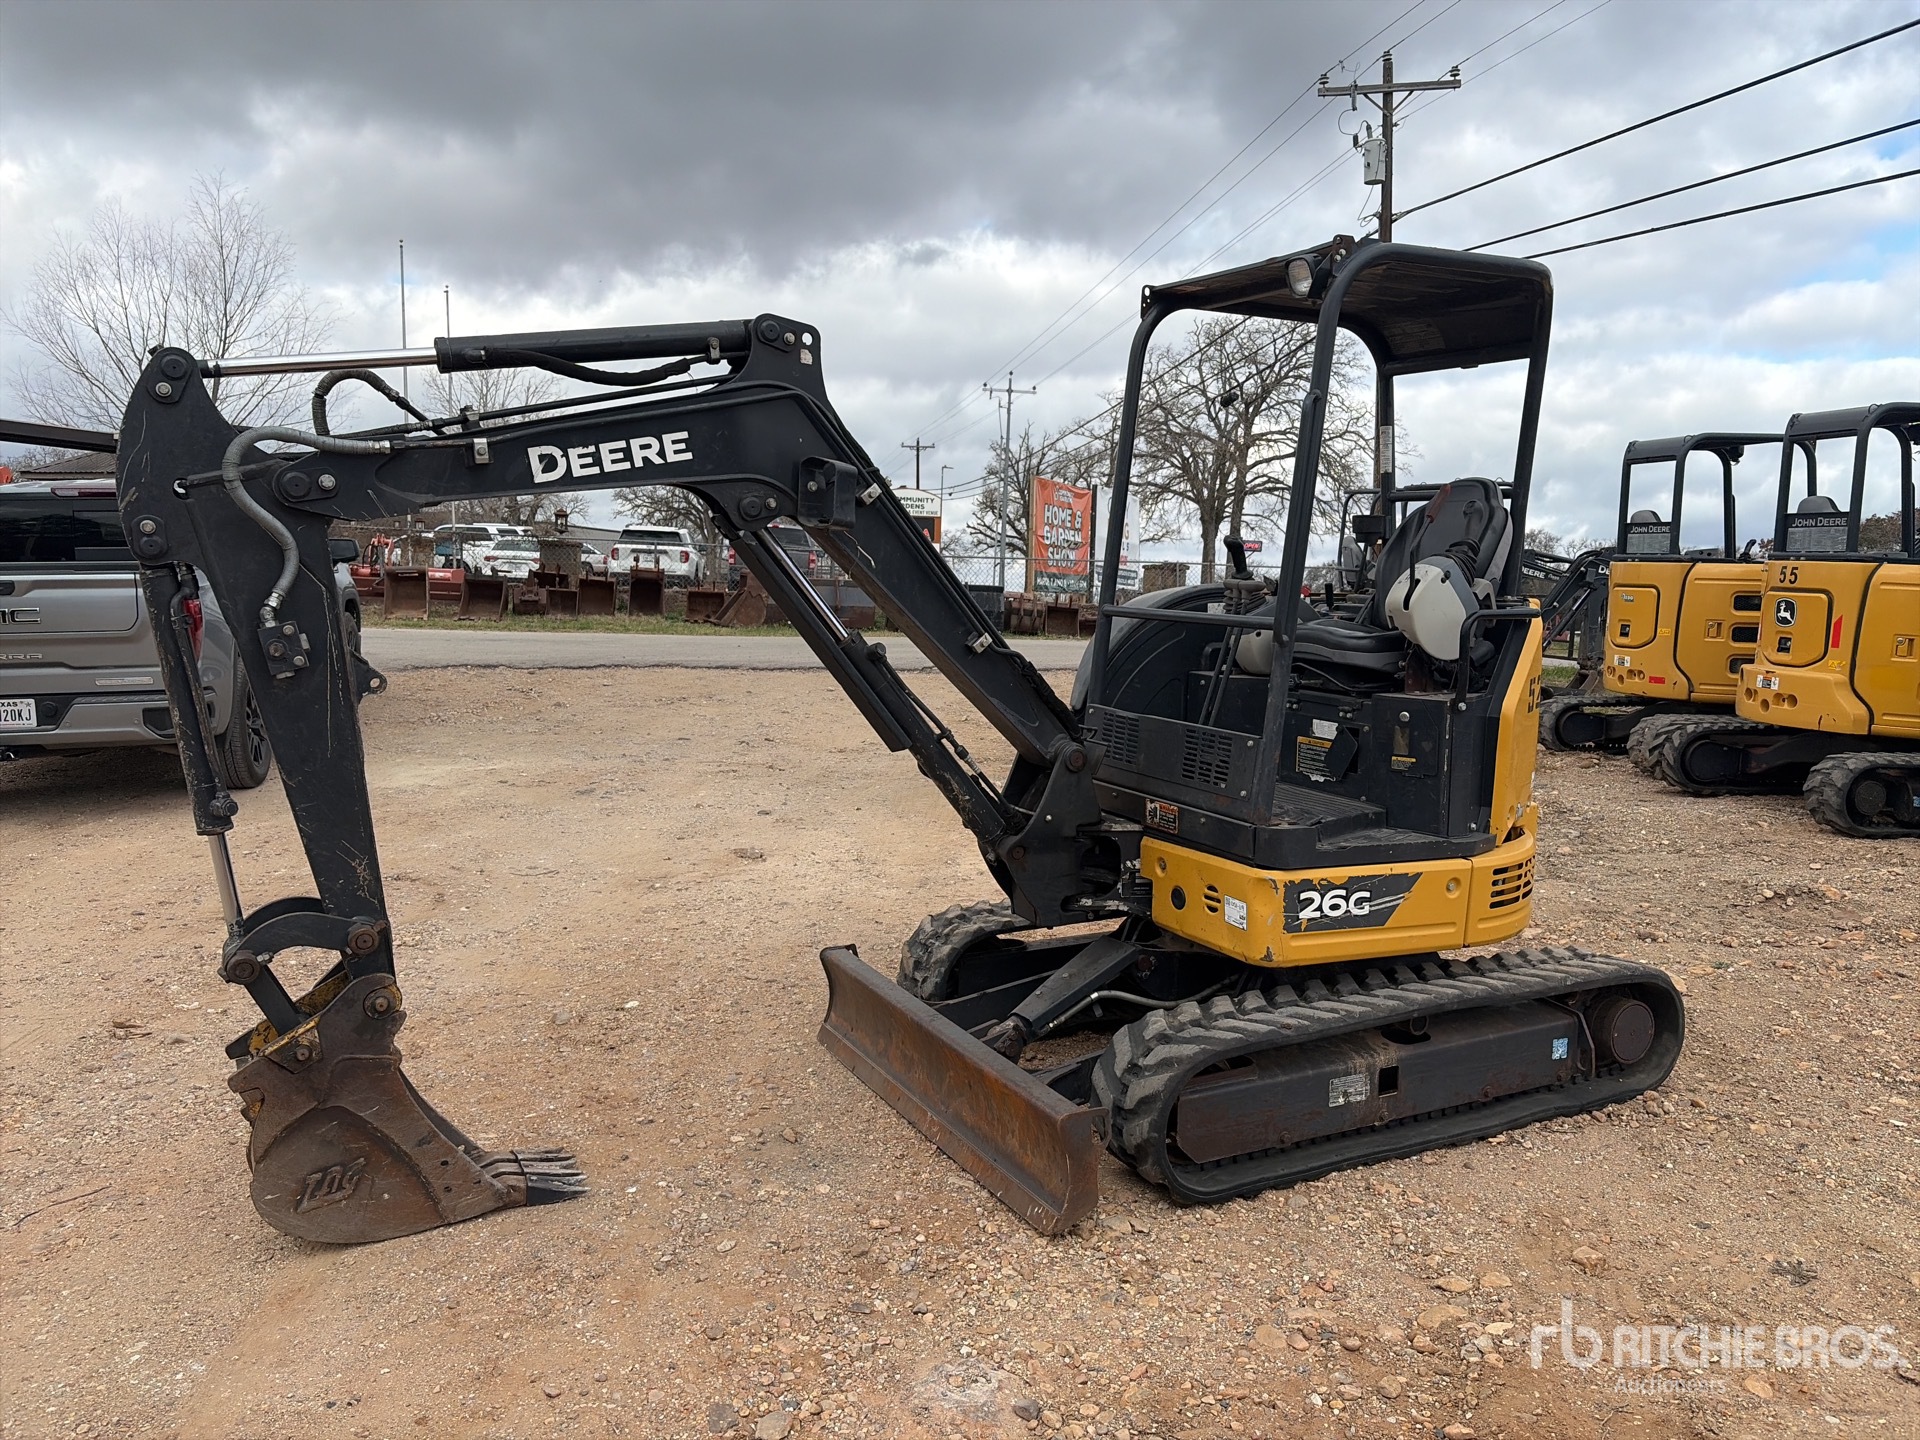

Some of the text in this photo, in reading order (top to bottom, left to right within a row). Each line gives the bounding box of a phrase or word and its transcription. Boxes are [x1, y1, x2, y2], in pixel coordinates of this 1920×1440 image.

[527, 431, 693, 484] DEERE
[896, 496, 935, 504] MMUNITY
[1044, 504, 1082, 529] HOME &
[1792, 517, 1847, 527] JOHN DEERE
[1043, 525, 1082, 549] GARDEN
[1648, 525, 1670, 533] DEERE
[1047, 546, 1076, 569] SHOW
[1779, 565, 1799, 585] 55
[1298, 889, 1371, 919] 26G
